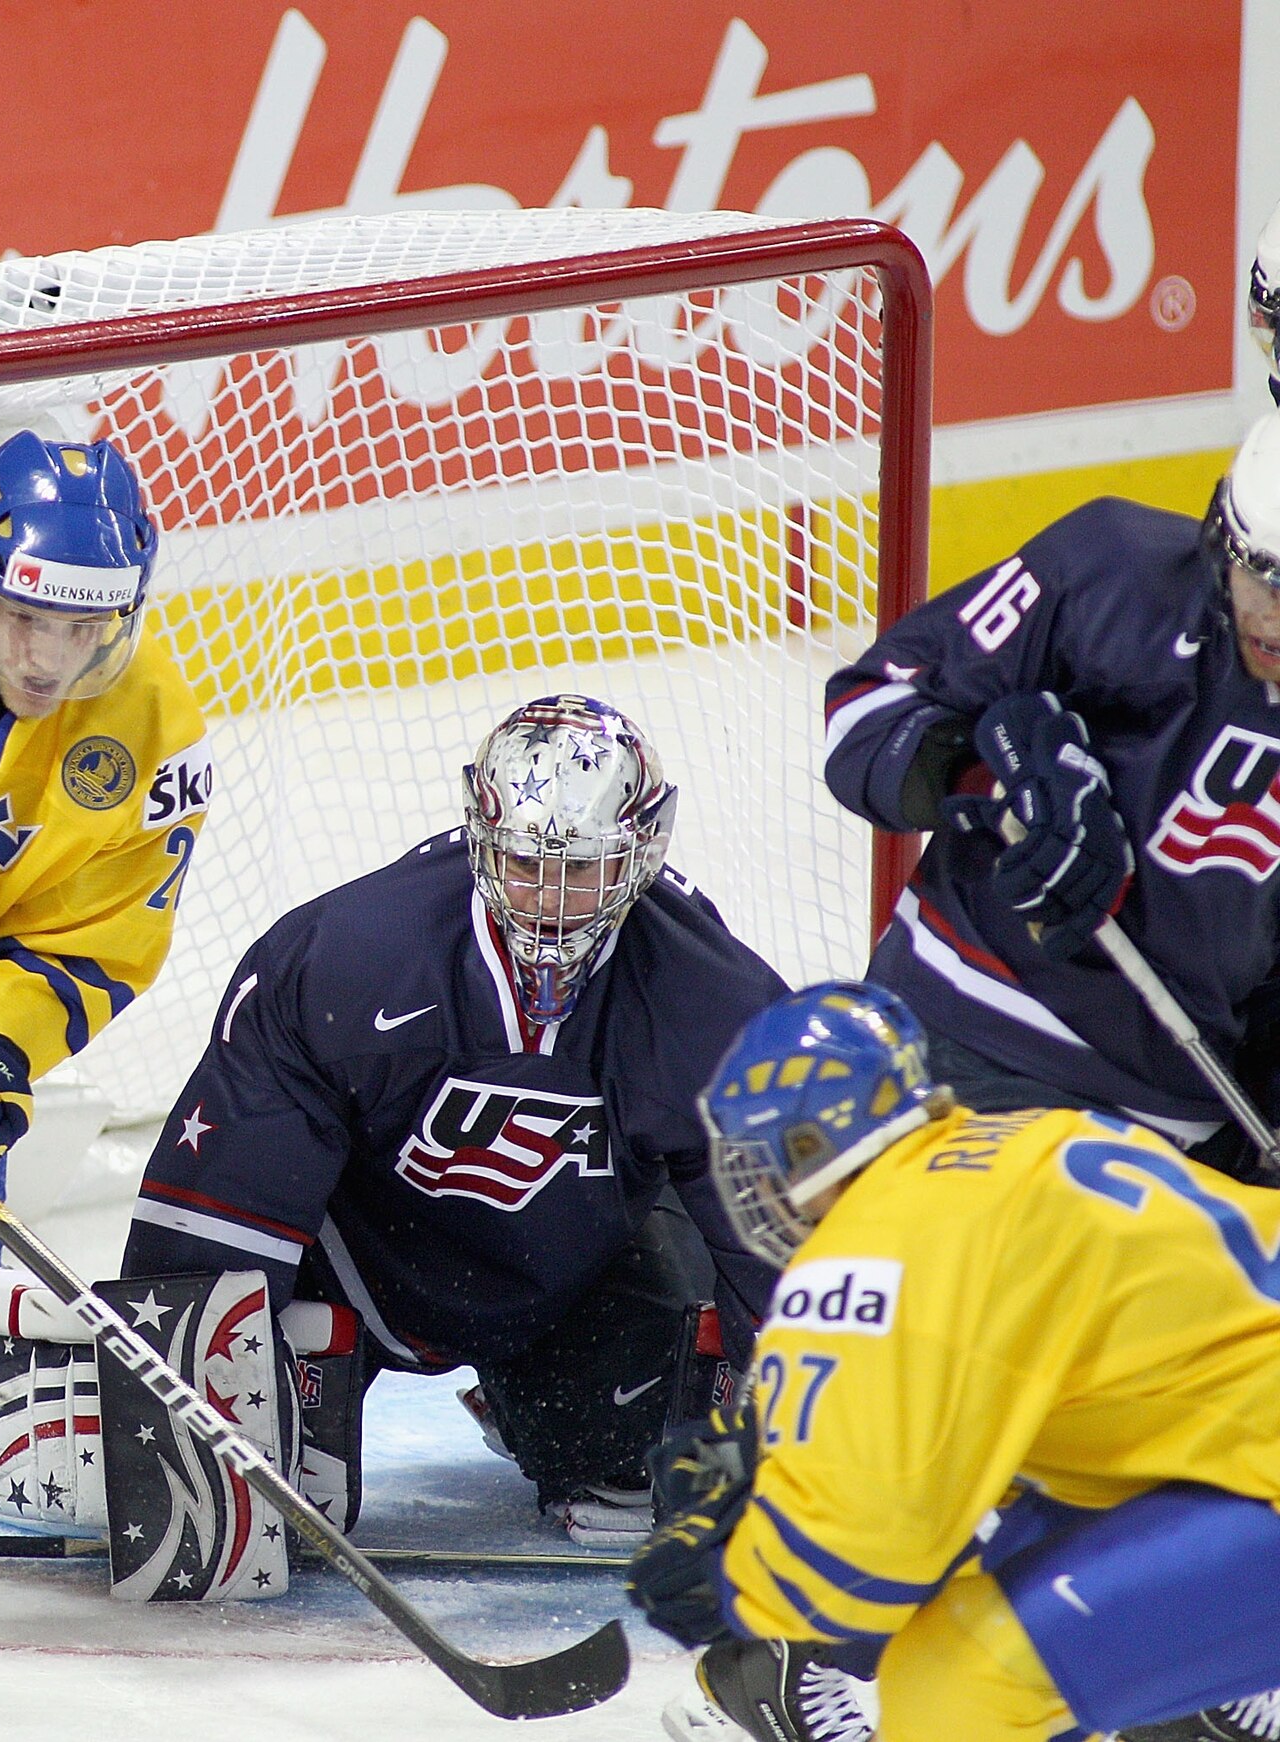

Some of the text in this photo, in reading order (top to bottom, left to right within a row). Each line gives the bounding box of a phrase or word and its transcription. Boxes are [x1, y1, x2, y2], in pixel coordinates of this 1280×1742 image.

[42, 583, 133, 603] SVENSKA SPEL
[957, 556, 1042, 653] 16
[146, 760, 212, 822] Ško
[145, 825, 197, 912] 2
[394, 1077, 615, 1212] USA
[780, 1271, 888, 1324] oda
[68, 1291, 265, 1477] BAUER
[760, 1352, 839, 1444] 27
